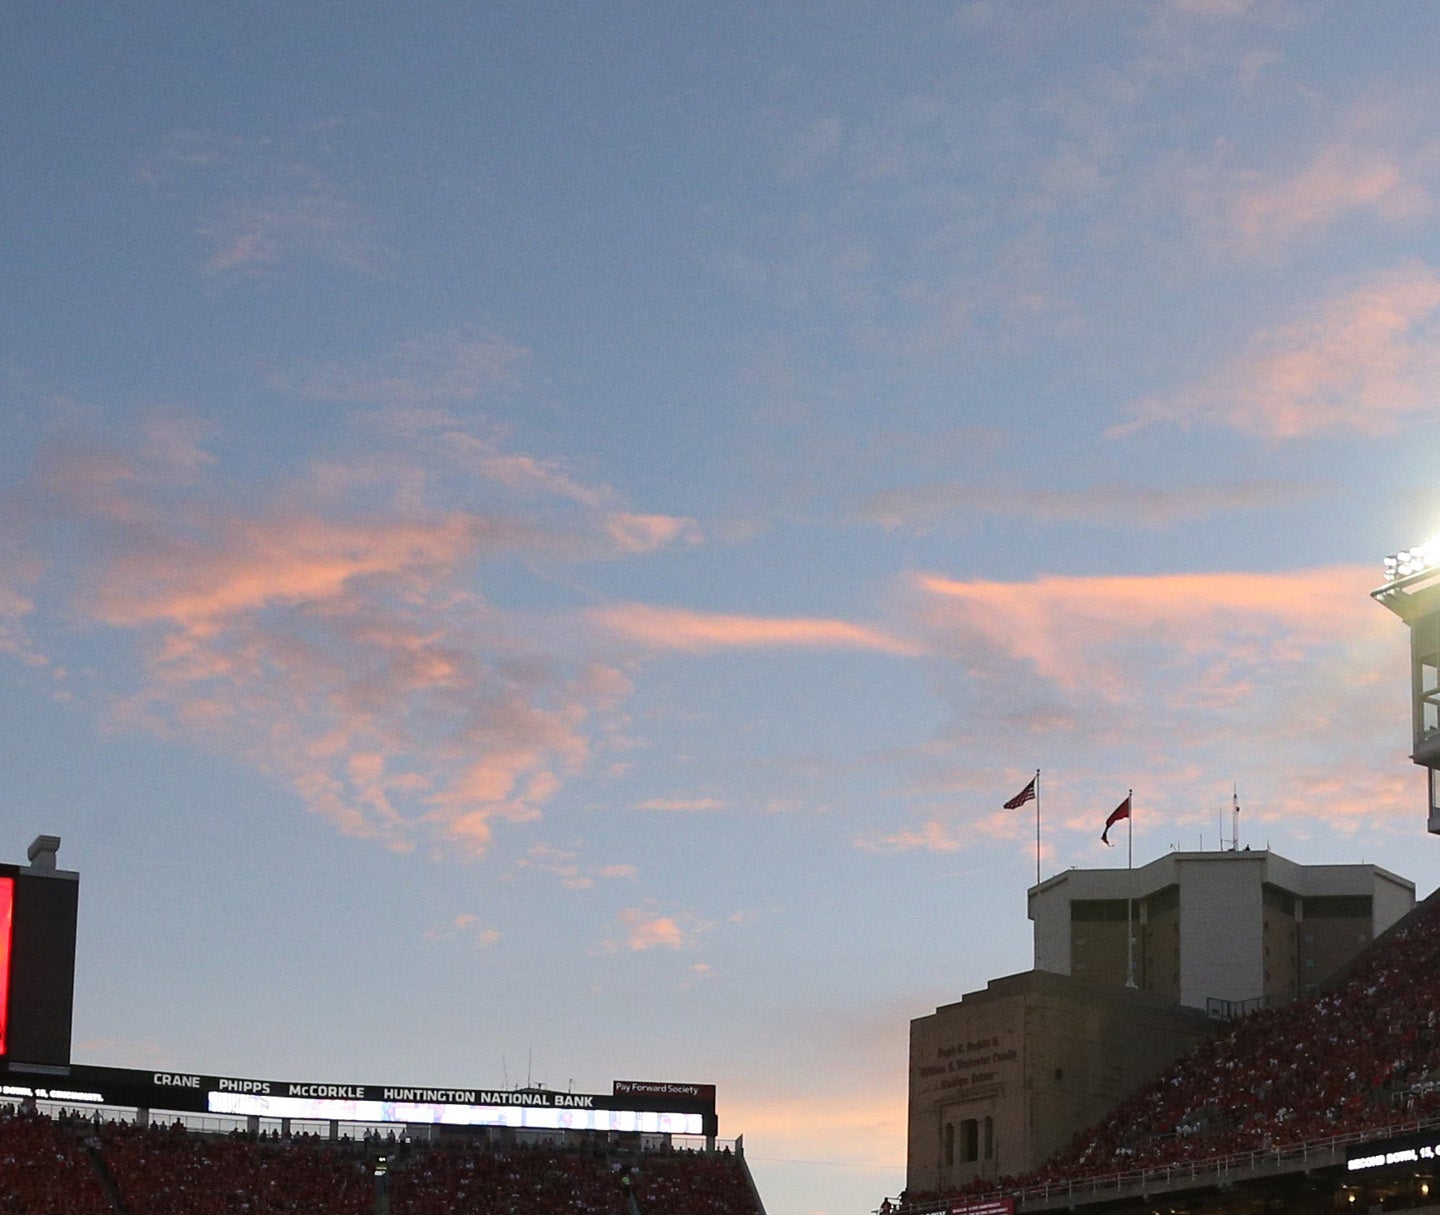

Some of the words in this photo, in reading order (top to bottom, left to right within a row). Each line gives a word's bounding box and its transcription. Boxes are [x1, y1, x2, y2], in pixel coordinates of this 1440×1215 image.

[153, 1073, 200, 1088] CRANE
[219, 1078, 271, 1094] PHIPPS
[288, 1084, 365, 1099] McCORKLE
[616, 1082, 631, 1093] Pay
[632, 1082, 666, 1093] Forward
[667, 1084, 699, 1096] Society
[383, 1087, 476, 1103] HUNTINGTON
[480, 1091, 551, 1106] NATIONAL
[554, 1095, 593, 1107] BANK
